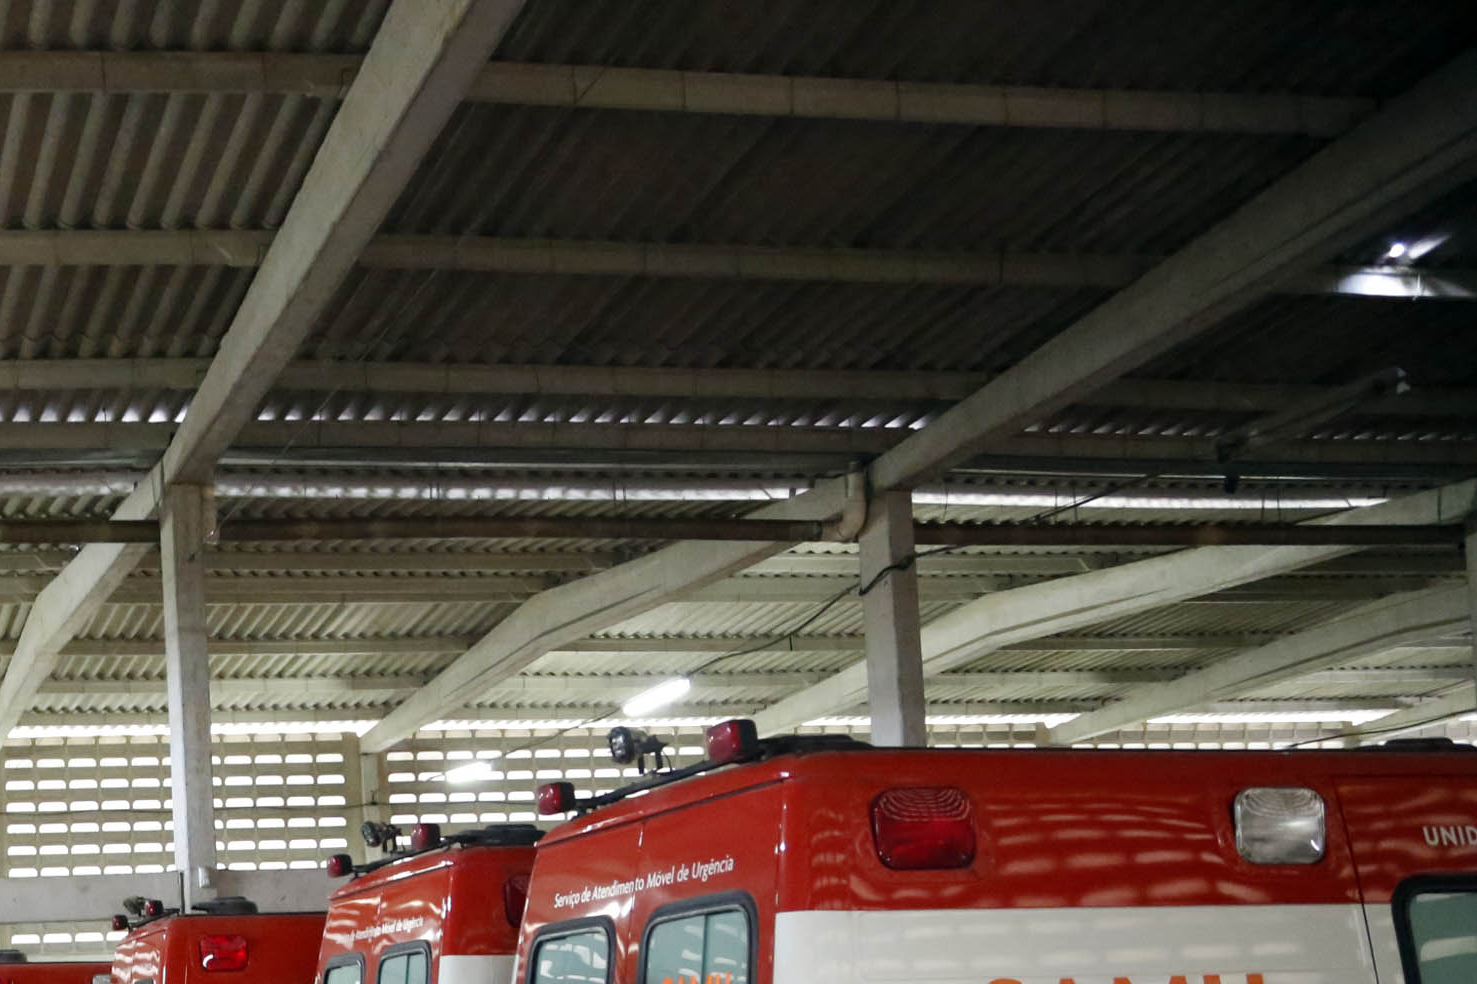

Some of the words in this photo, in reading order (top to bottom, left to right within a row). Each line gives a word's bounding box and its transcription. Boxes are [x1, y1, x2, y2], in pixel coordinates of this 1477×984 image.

[553, 892, 580, 909] Serviço
[581, 886, 591, 902] de
[592, 880, 644, 900] Atendimento
[646, 866, 675, 888] Móvel
[676, 864, 690, 882] de
[691, 855, 734, 882] Urgência
